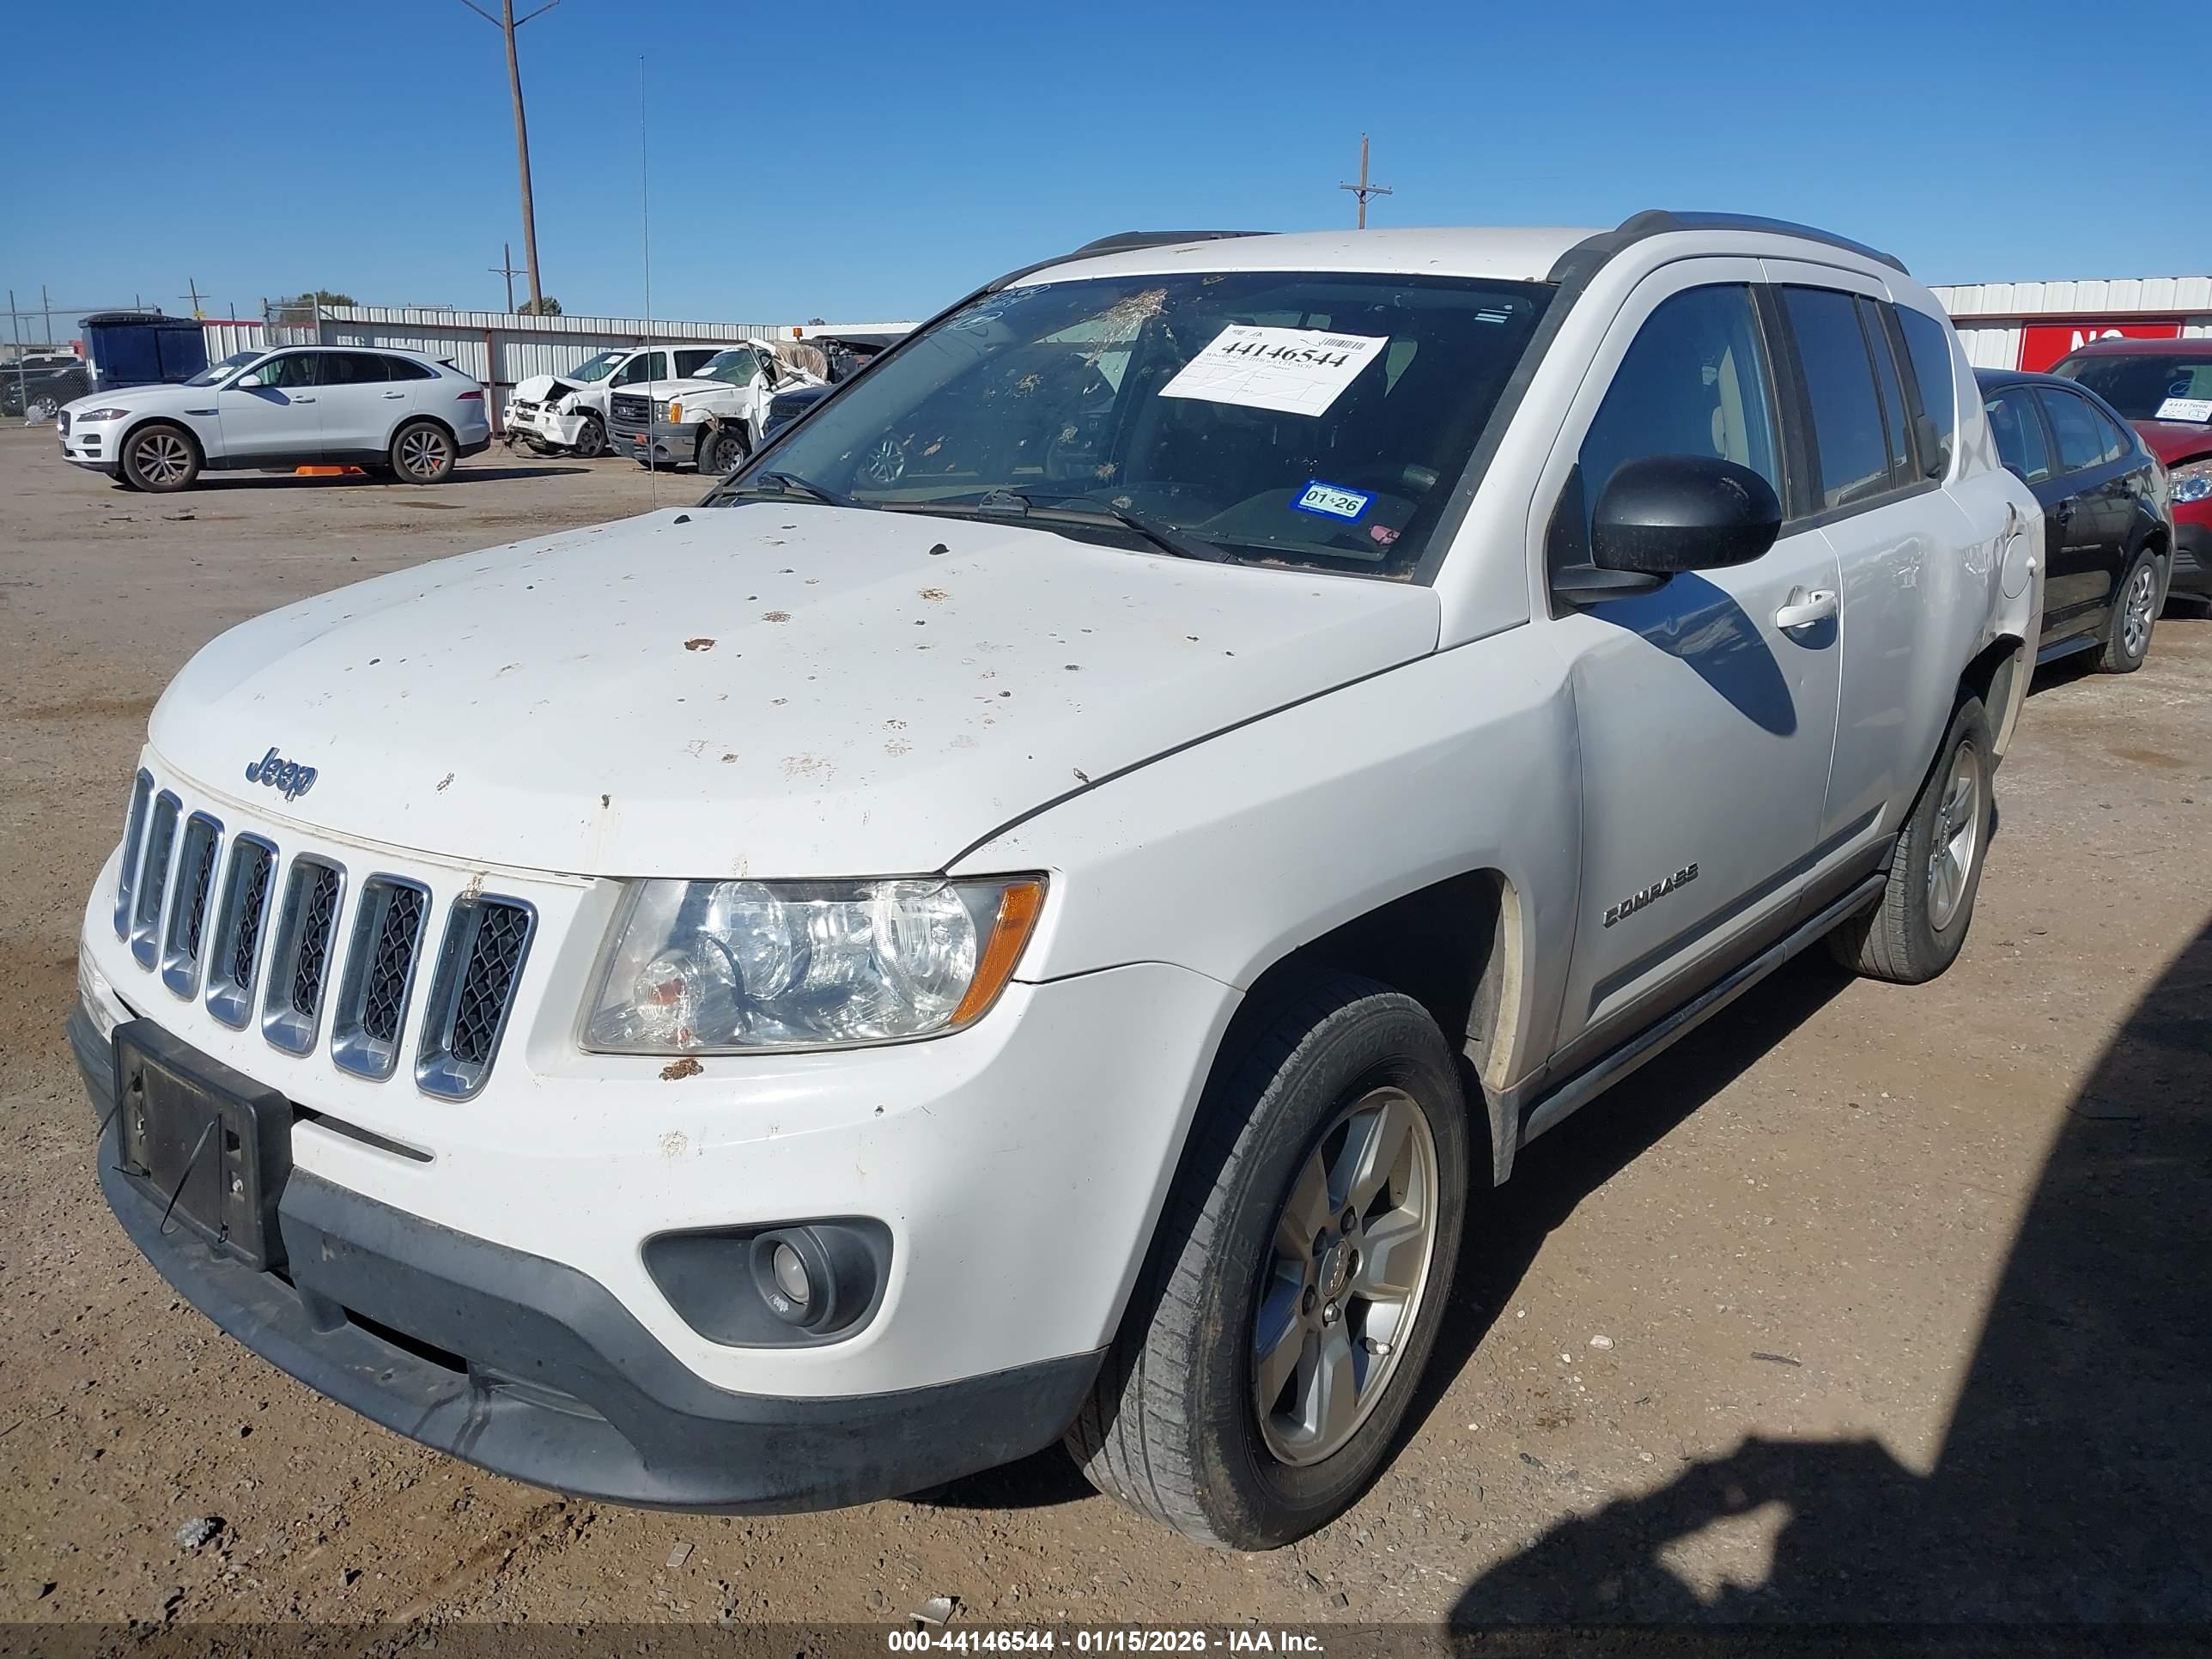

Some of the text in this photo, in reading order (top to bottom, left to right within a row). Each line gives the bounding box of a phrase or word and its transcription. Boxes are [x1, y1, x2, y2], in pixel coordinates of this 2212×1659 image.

[1221, 341, 1350, 368] 44146544
[1305, 490, 1328, 504] 01
[1334, 497, 1359, 512] 26
[246, 746, 319, 802] Jeep
[1602, 862, 1698, 928] COMPASS
